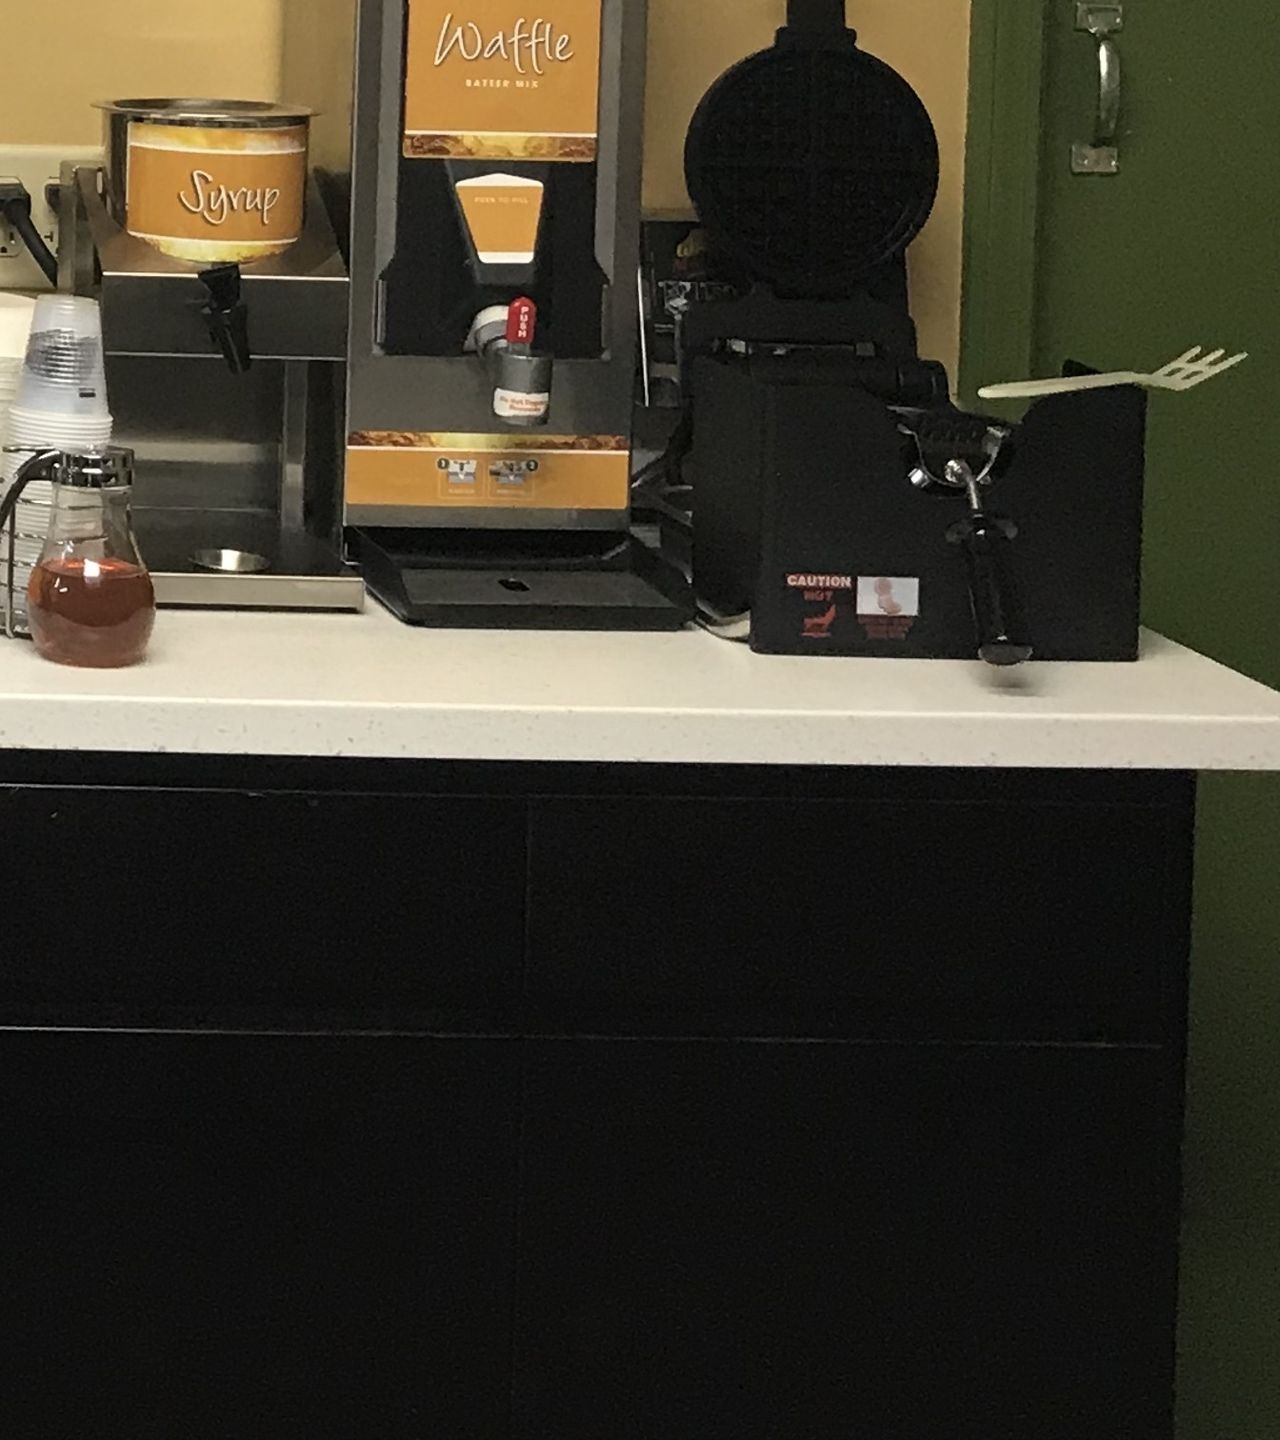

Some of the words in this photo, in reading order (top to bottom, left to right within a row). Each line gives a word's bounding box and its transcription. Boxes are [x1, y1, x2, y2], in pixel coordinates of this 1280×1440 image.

[434, 13, 575, 74] Waffle
[515, 79, 539, 88] MIX
[180, 170, 280, 224] Syrup
[517, 305, 530, 338] PUSH
[787, 574, 852, 588] CAUTION
[804, 590, 833, 602] HOT
